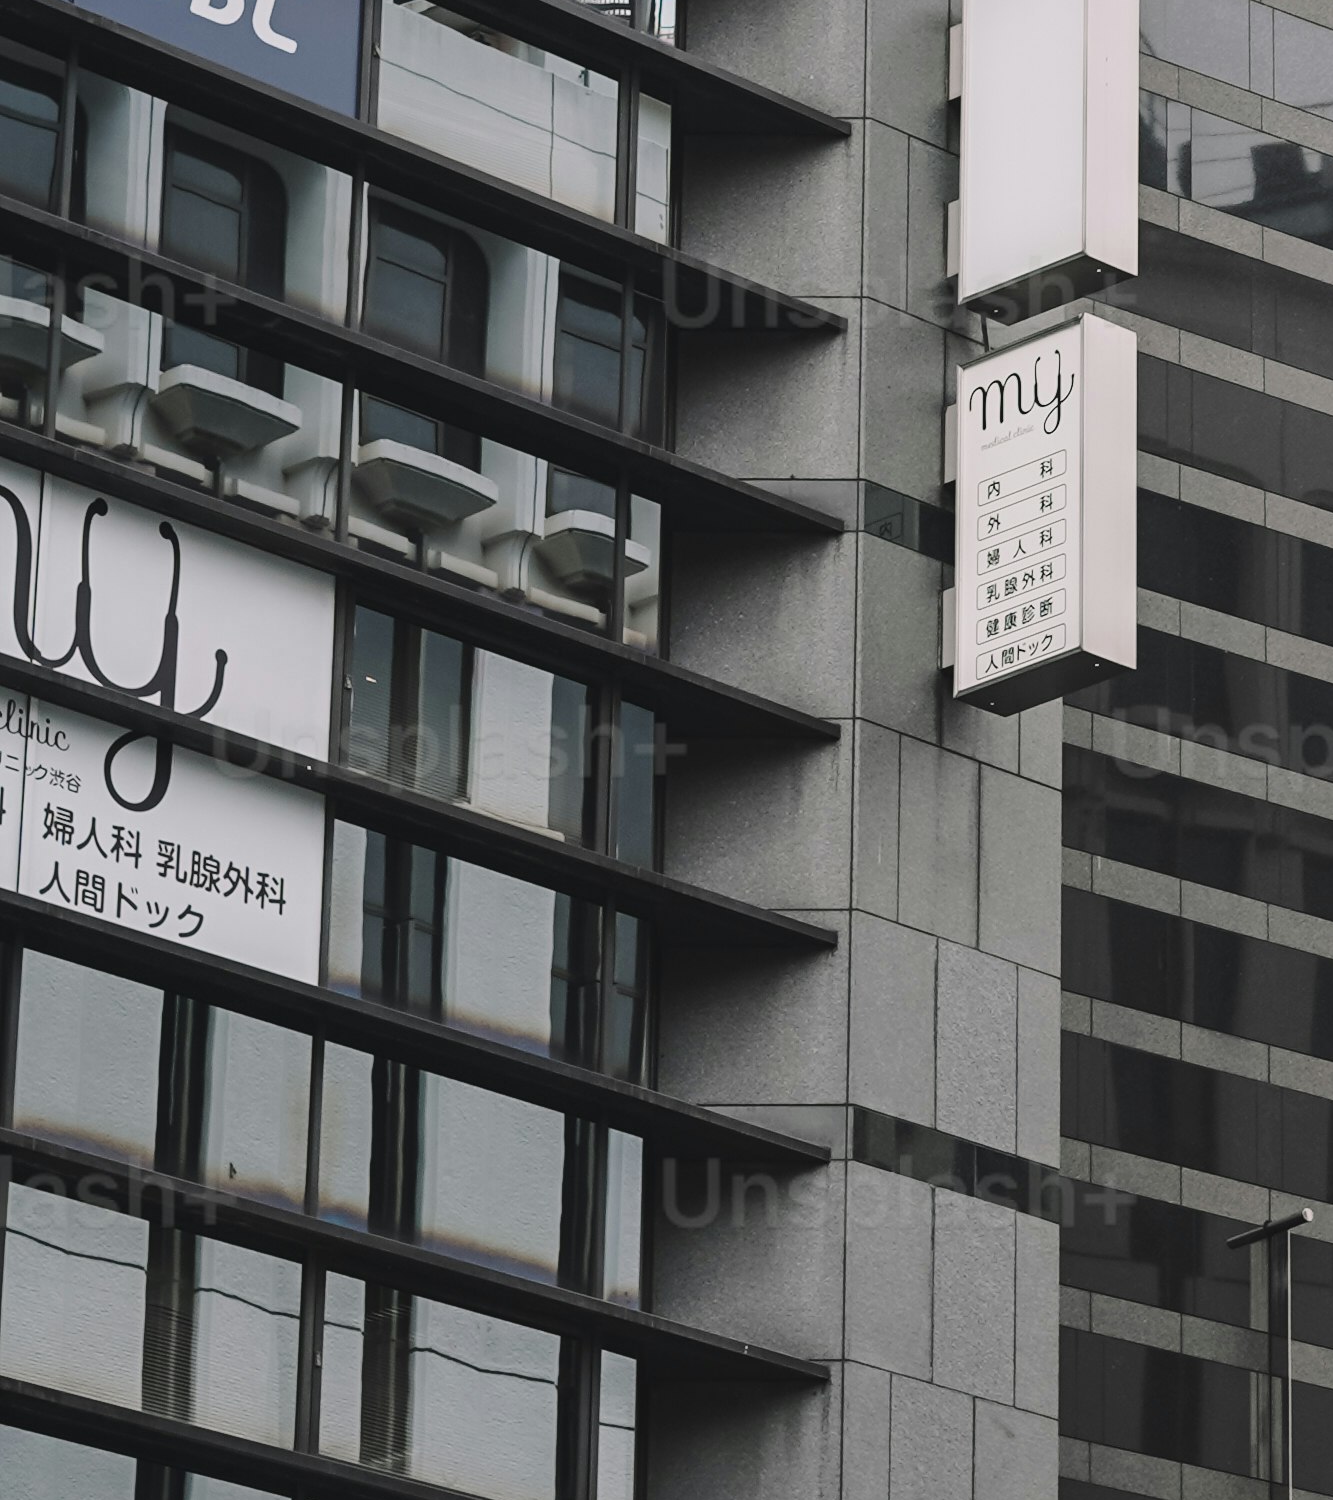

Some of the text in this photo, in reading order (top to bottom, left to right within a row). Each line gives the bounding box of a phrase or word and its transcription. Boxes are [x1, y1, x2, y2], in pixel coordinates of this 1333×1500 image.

[968, 348, 1075, 435] my
[985, 634, 1053, 674] 人間ドック
[0, 698, 71, 752] linic
[42, 801, 143, 870] 婦人科
[155, 839, 287, 916] 乳腺外科
[38, 861, 205, 938] 人間ドック
